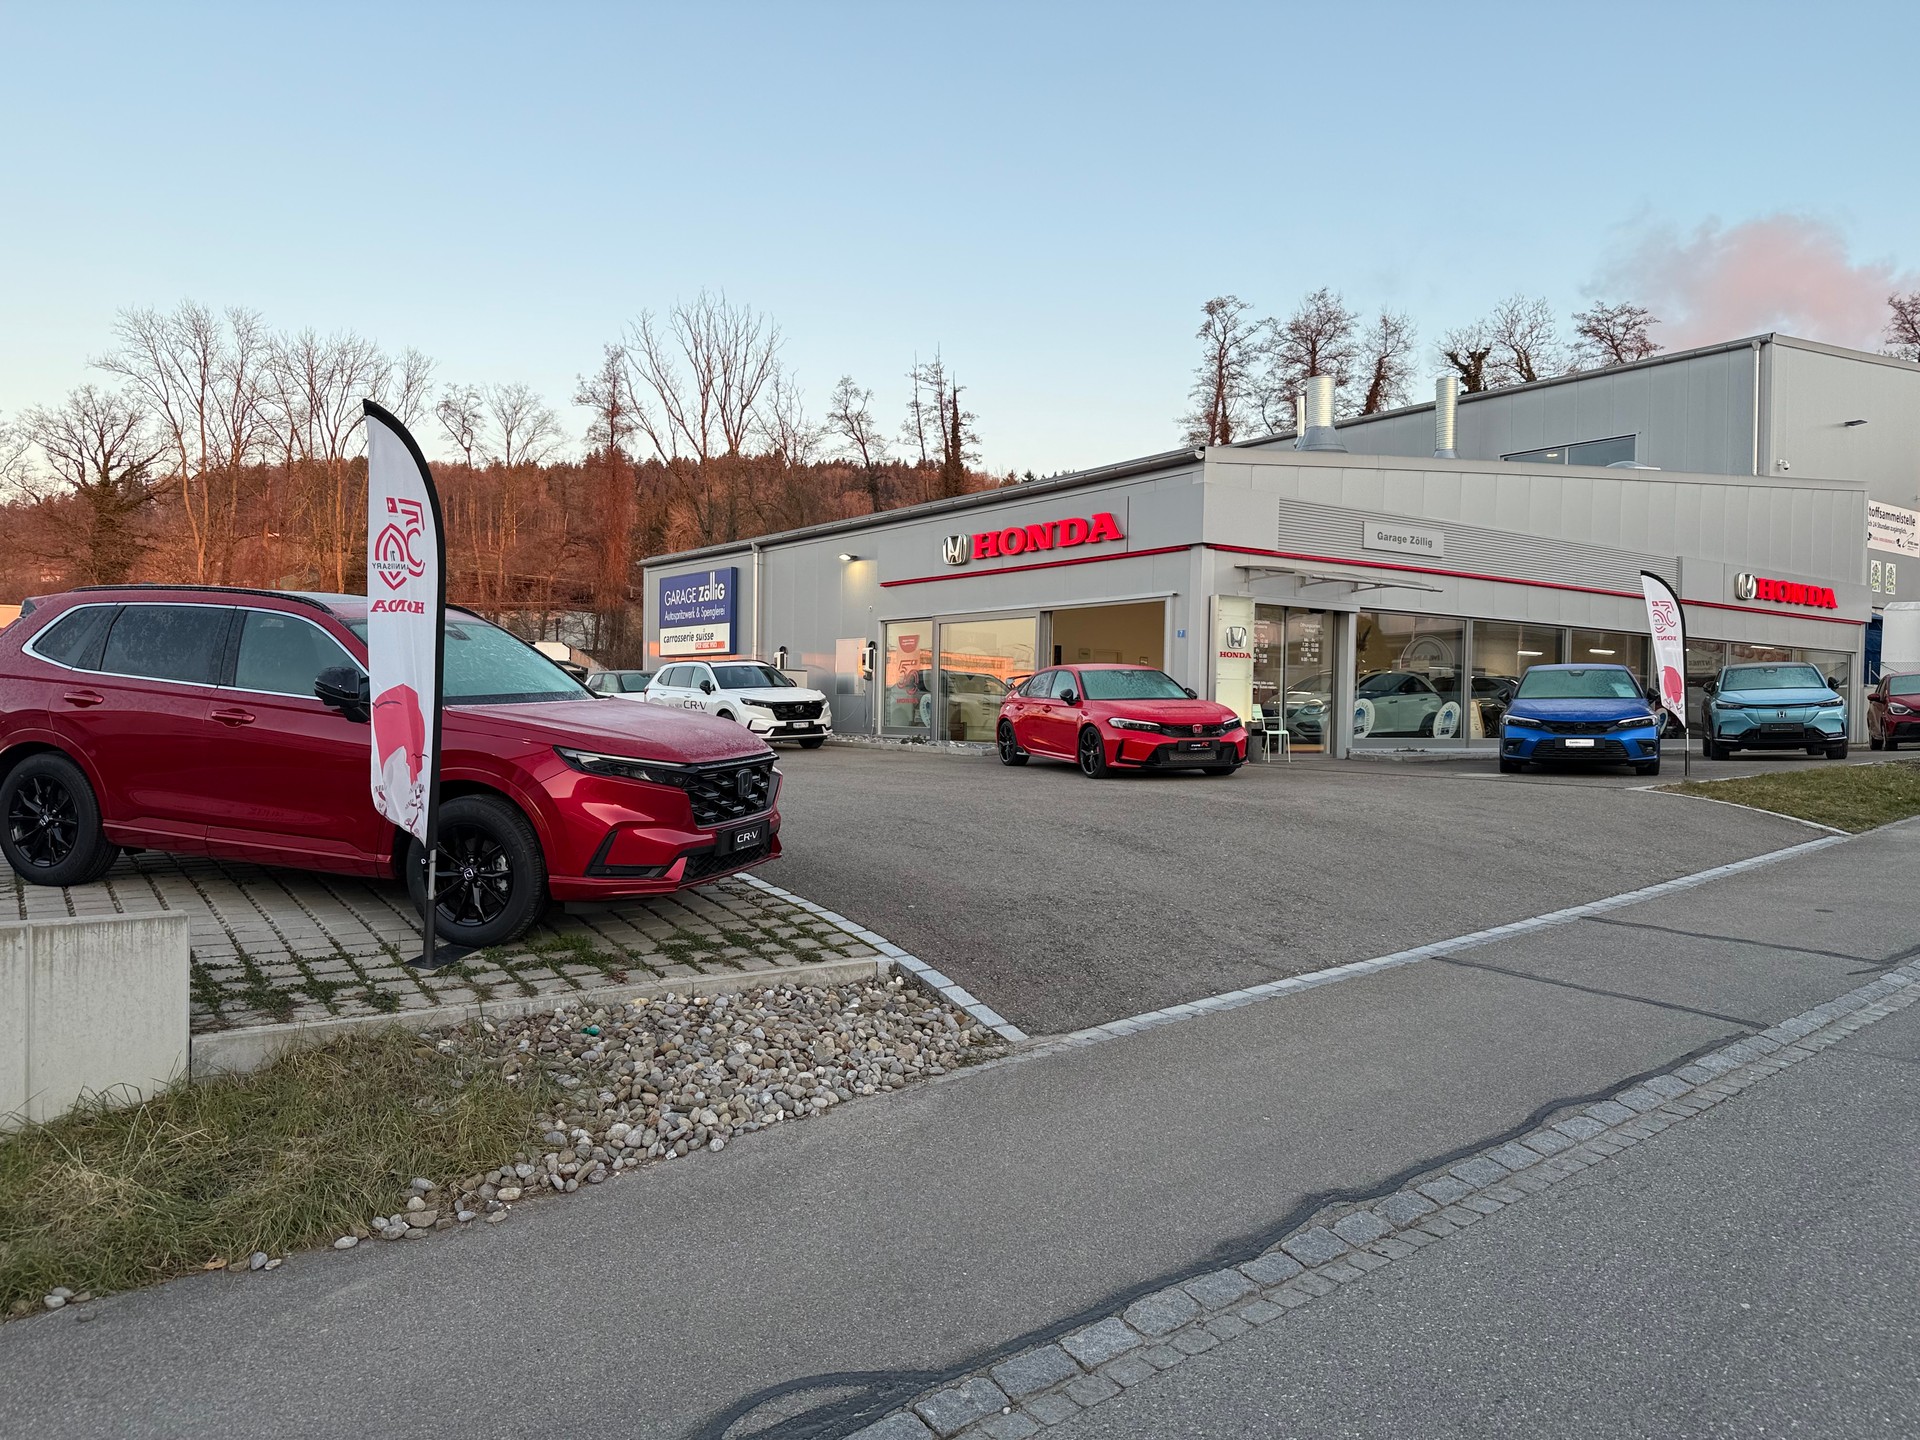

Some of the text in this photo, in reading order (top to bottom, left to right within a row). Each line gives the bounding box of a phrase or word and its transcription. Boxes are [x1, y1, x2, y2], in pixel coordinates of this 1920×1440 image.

[971, 512, 1124, 559] HONDA
[1377, 531, 1433, 549] Garage Zöllig
[664, 587, 697, 606] GARAGE
[1755, 578, 1838, 609] HONDA
[696, 606, 700, 618] &
[700, 604, 726, 621] Spenglerei
[663, 629, 715, 644] carrosserie suisse
[1219, 651, 1252, 659] HONDA
[683, 700, 708, 710] CR-V
[736, 830, 759, 843] CR-V
